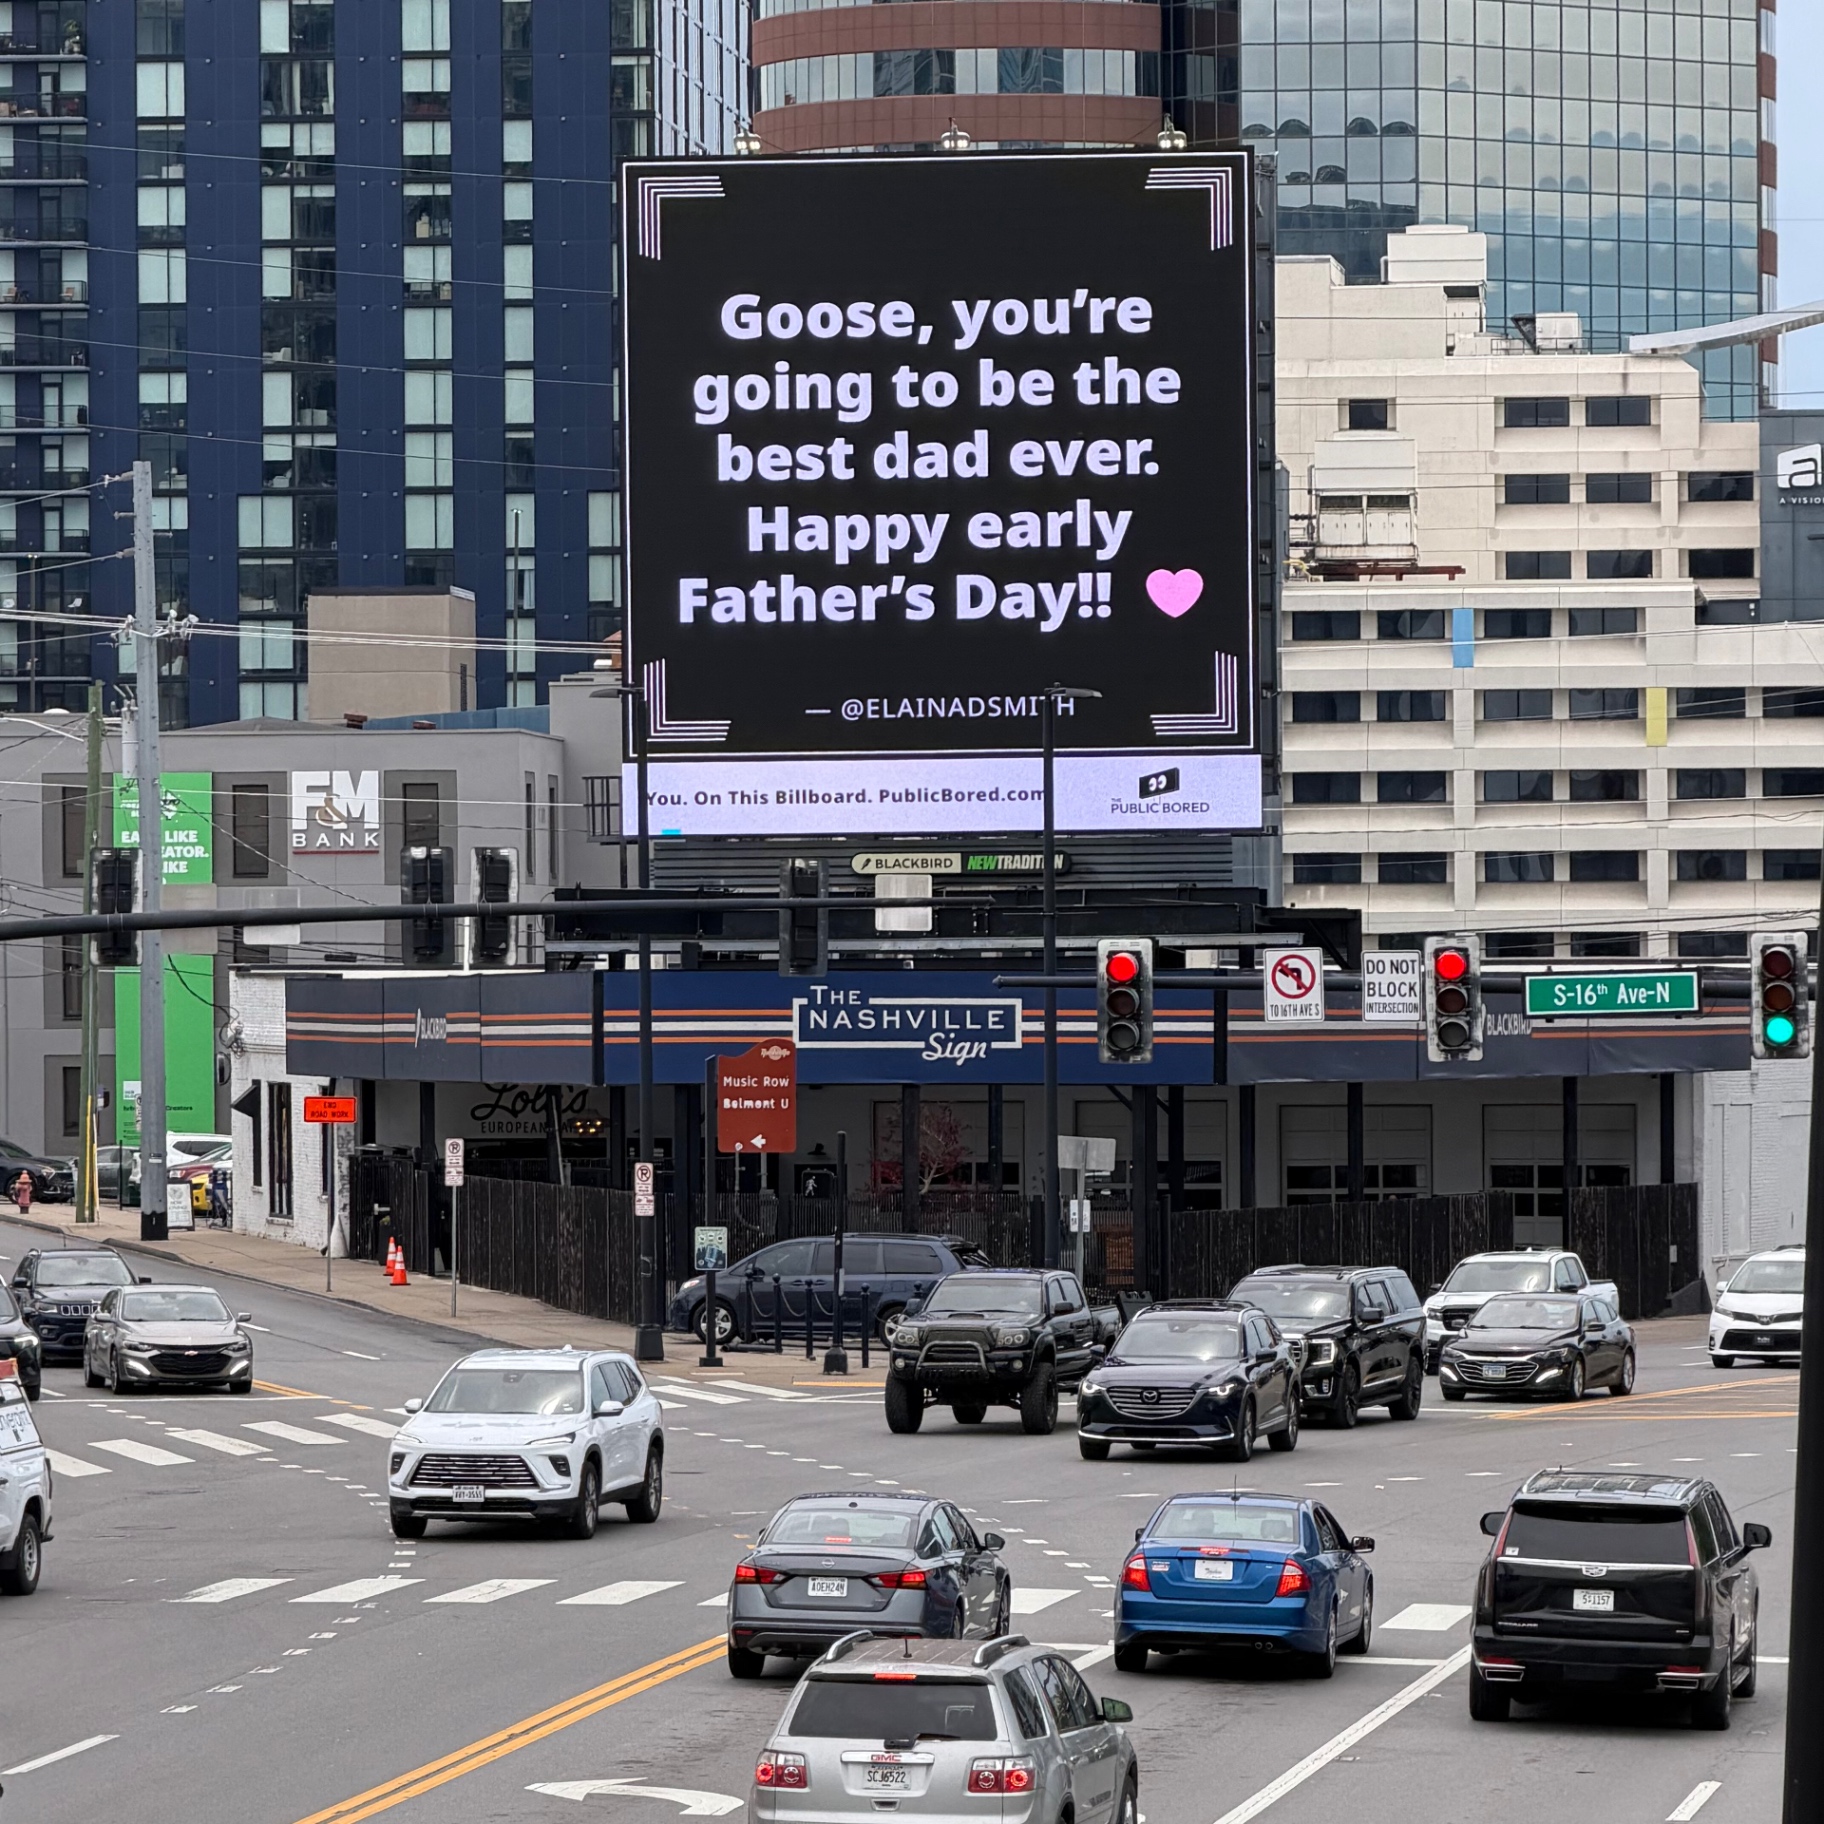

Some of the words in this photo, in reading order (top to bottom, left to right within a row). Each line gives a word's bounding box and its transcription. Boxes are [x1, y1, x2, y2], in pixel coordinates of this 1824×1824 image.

[720, 294, 934, 345] Goose,
[951, 289, 1153, 350] you’re
[693, 361, 872, 425] going
[892, 366, 959, 408] to
[979, 359, 1055, 407] be
[1073, 356, 1182, 405] the
[717, 434, 855, 482] best
[873, 430, 989, 480] dad
[1010, 438, 1160, 477] ever.
[747, 506, 950, 565] Happy
[967, 499, 1133, 561] early
[679, 574, 936, 624] Father’s
[955, 572, 1112, 633] Day!!
[291, 770, 380, 830] F&M
[648, 792, 688, 806] You.
[694, 791, 721, 806] On
[728, 790, 769, 805] This
[776, 789, 872, 805] Billboard.
[879, 787, 1044, 803] PublicBored.com
[1111, 803, 1159, 814] PUBLIC
[1162, 802, 1210, 813] BORED
[164, 830, 199, 843] LIKE
[292, 832, 379, 847] BANK
[161, 845, 210, 858] EATOR.
[161, 861, 189, 874] IKE
[875, 858, 953, 869] BLACKBIRD
[1366, 959, 1386, 975] DO
[1390, 959, 1418, 975] NOT
[810, 985, 861, 1005] THE
[1366, 982, 1418, 998] BLOCK
[1553, 984, 1608, 1006] S-16th
[1616, 981, 1670, 1004] Ave-N
[1270, 1004, 1279, 1017] TO
[1281, 1004, 1298, 1018] 16TH
[1299, 1003, 1313, 1017] AVE
[1314, 1003, 1320, 1017] S
[1366, 1002, 1419, 1014] INTERSECTION
[809, 1009, 1005, 1030] NASHVILLE
[1486, 1013, 1533, 1036] BLACKBIRD
[922, 1032, 987, 1066] Sign
[723, 1075, 758, 1087] Music
[763, 1075, 790, 1087] Row
[470, 1084, 590, 1121] Lol's
[723, 1097, 775, 1109] Belmont
[780, 1098, 790, 1109] U
[310, 1110, 328, 1118] ROAD
[331, 1110, 349, 1118] WORK
[481, 1121, 547, 1134] EUROPEAN
[870, 1754, 902, 1762] GMC
